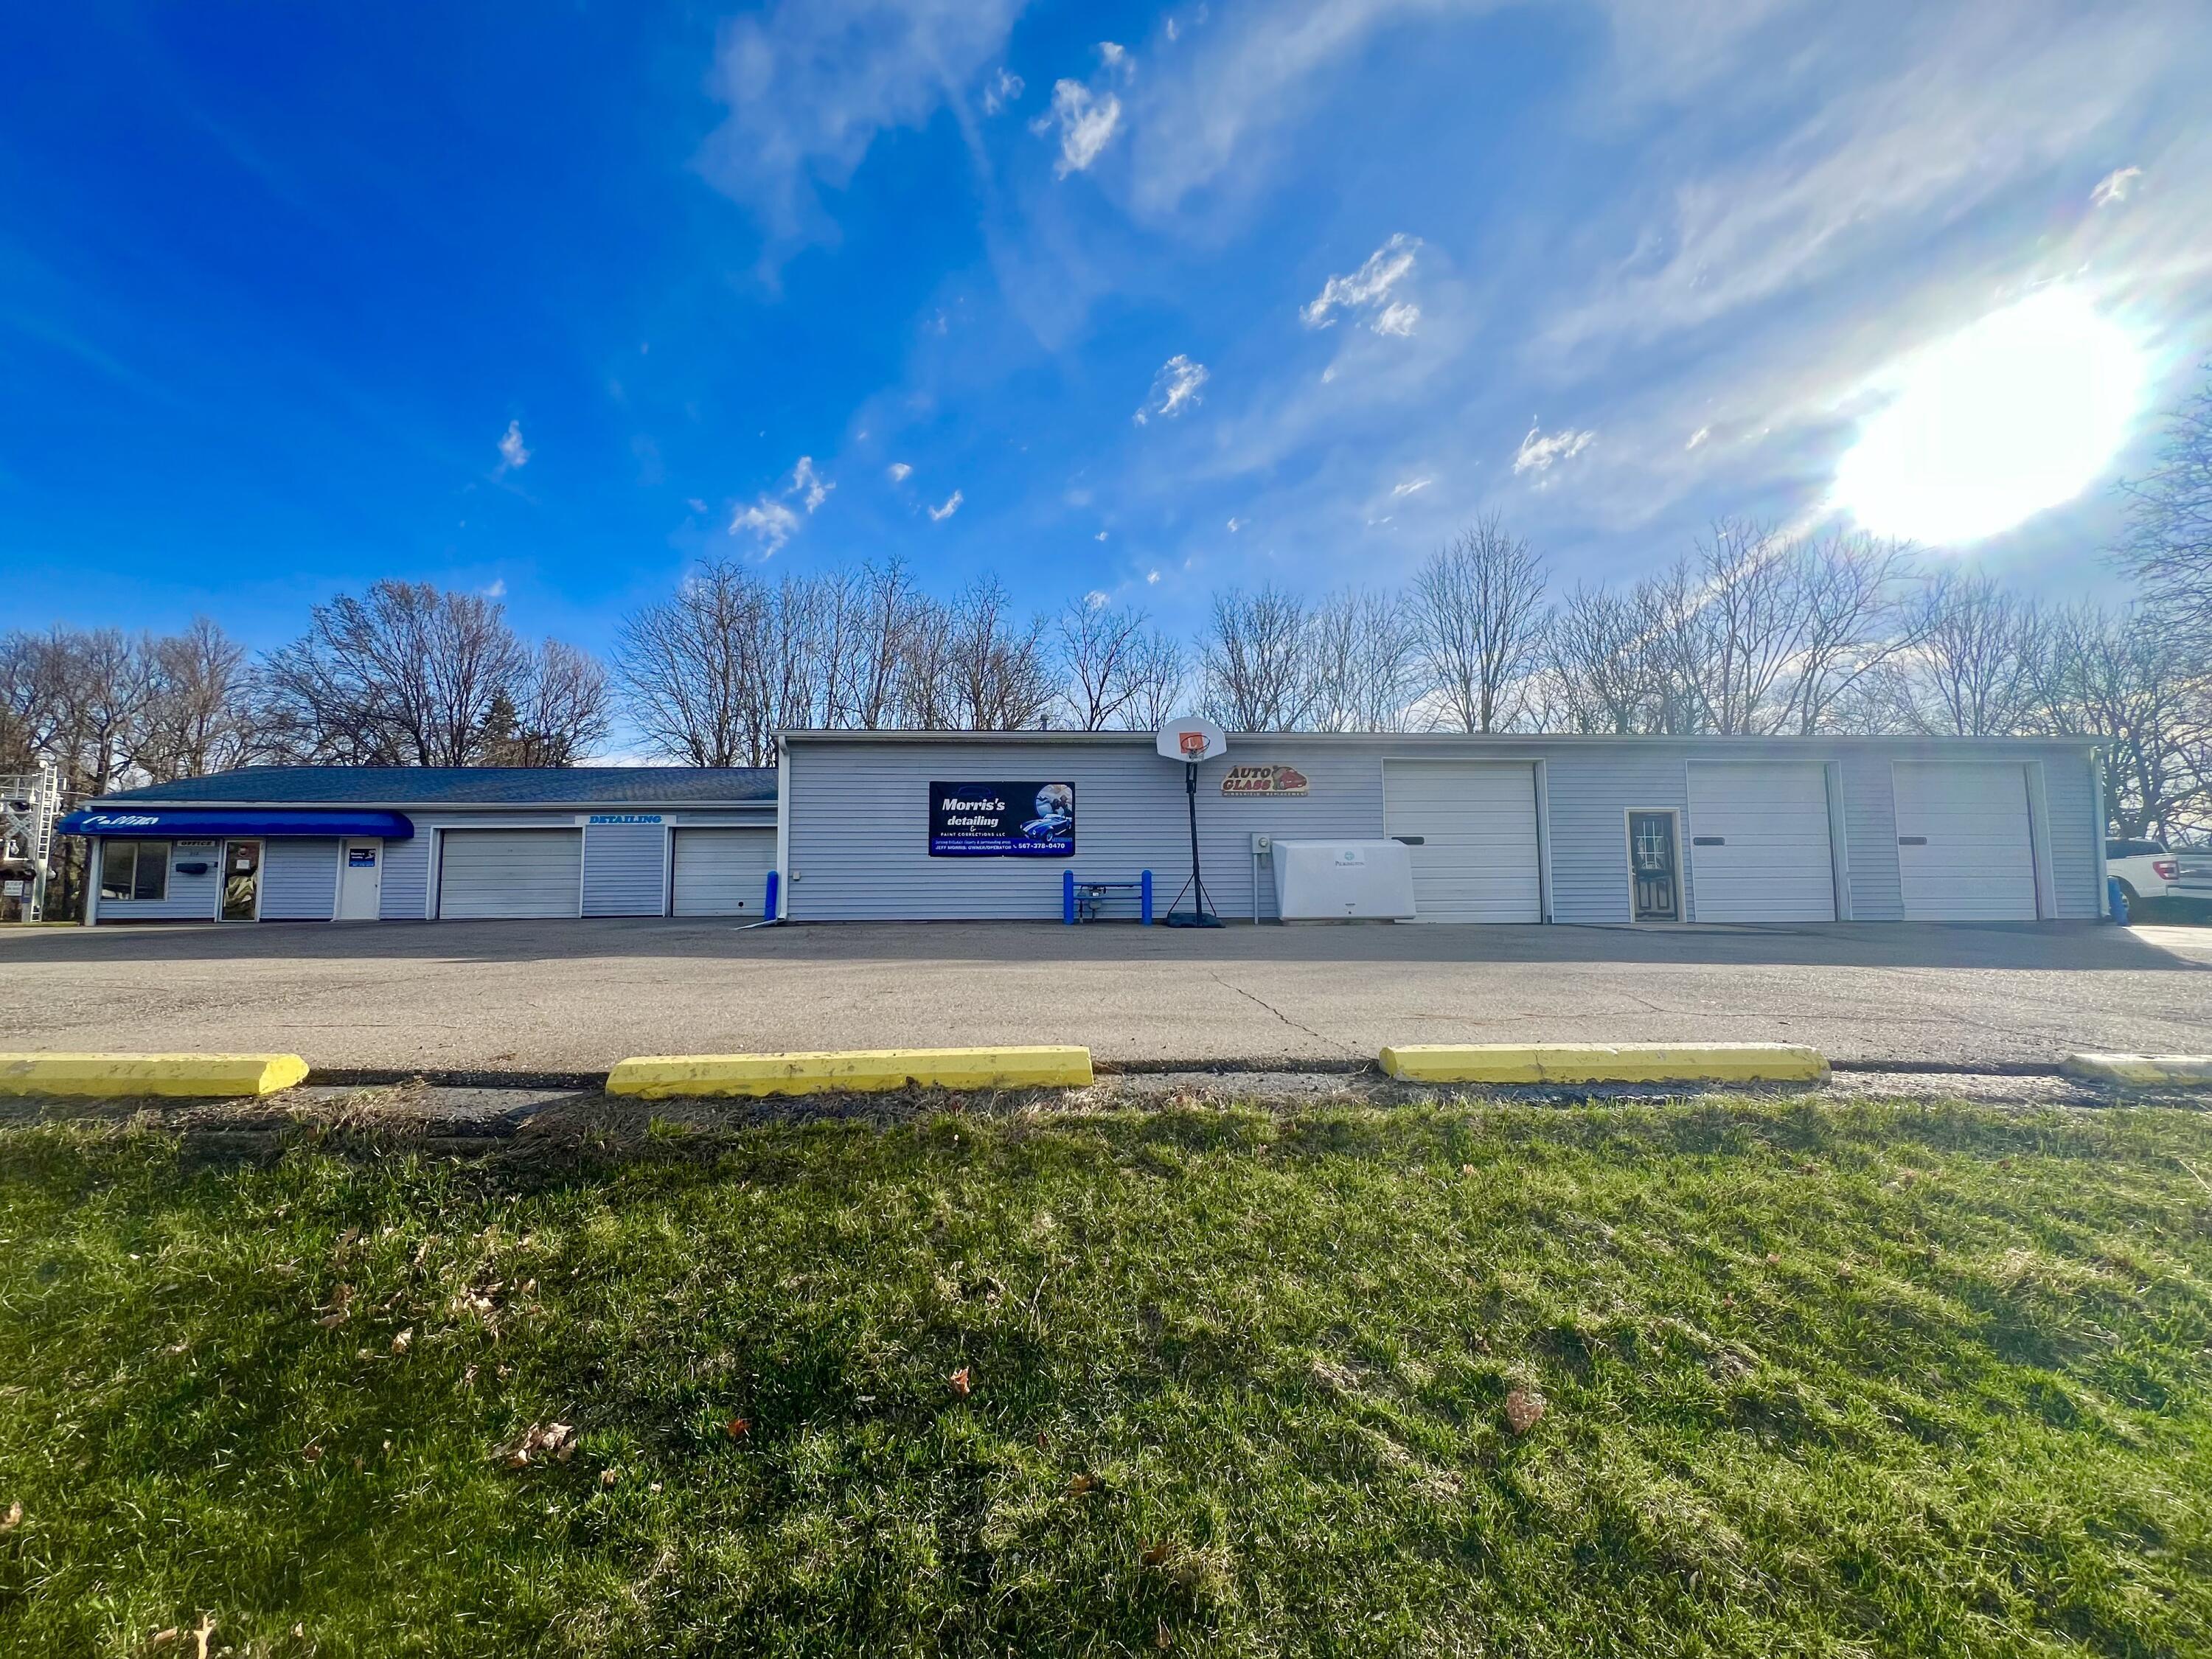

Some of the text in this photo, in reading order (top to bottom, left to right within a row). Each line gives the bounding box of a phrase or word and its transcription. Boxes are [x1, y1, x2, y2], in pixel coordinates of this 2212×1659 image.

[1228, 768, 1270, 779] AUTO
[1223, 780, 1271, 790] GLASS
[942, 798, 1005, 811] Morris's
[589, 815, 662, 824] DETAILING
[947, 815, 998, 827] detailing
